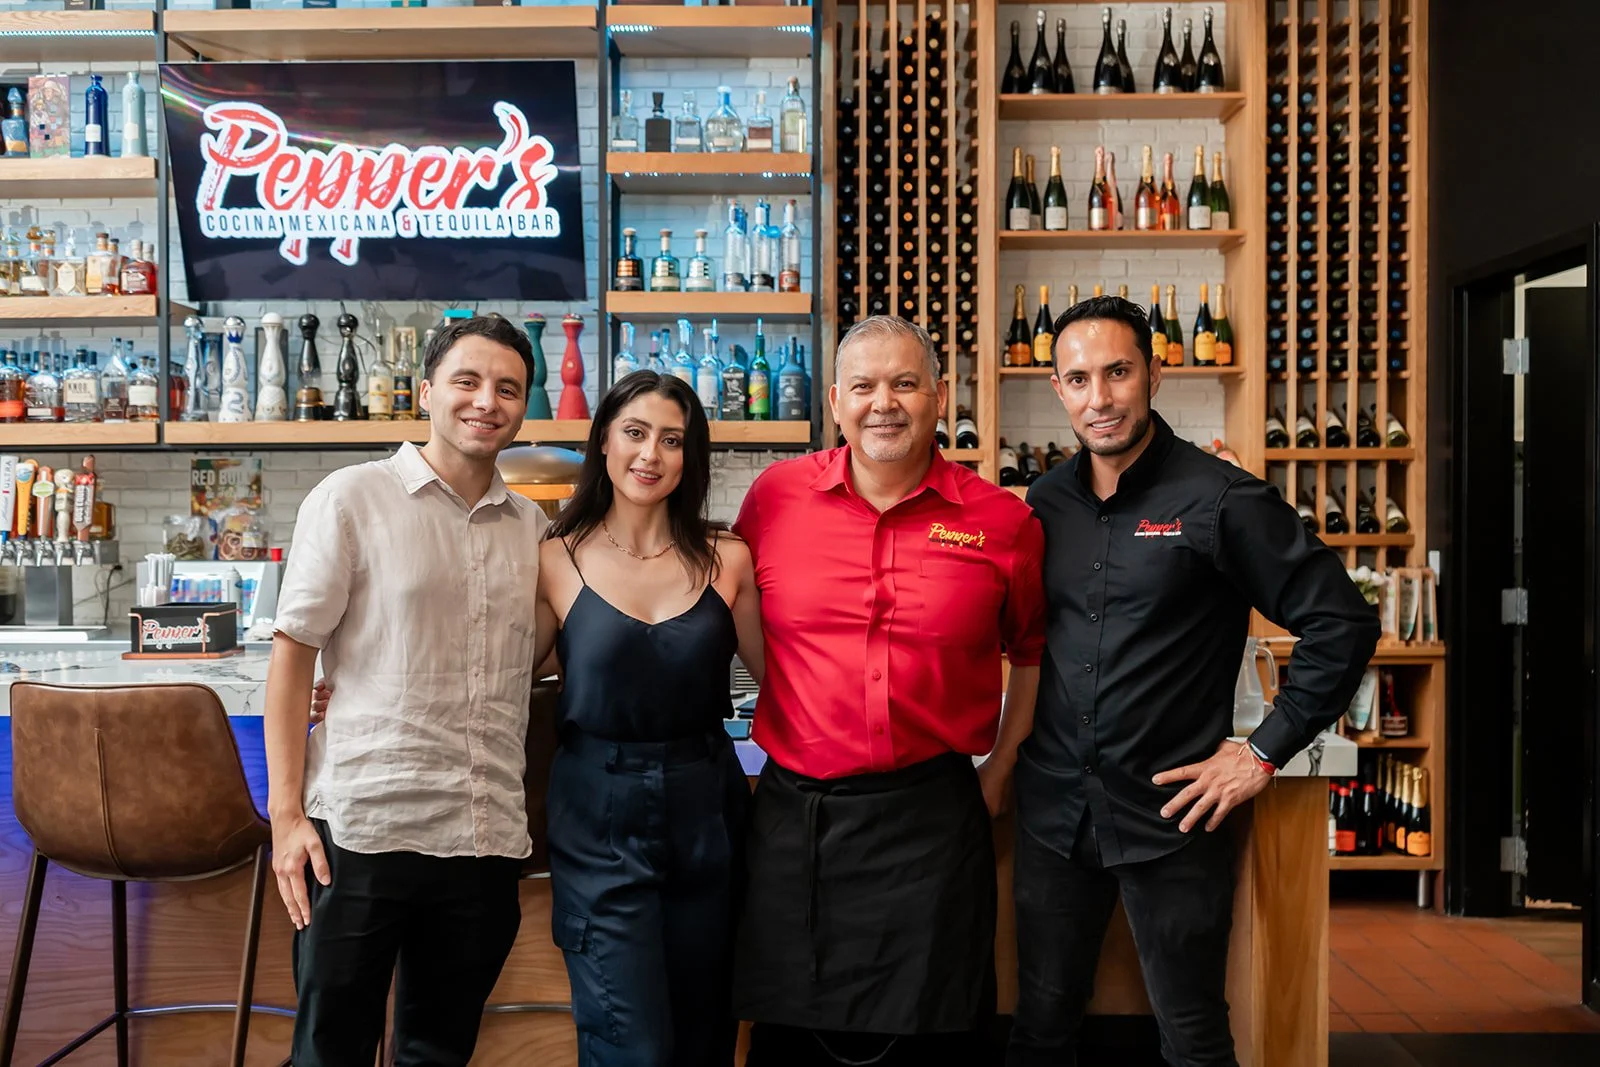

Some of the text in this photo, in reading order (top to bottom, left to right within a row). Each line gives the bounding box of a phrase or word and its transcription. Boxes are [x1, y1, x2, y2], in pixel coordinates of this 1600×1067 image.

[202, 103, 552, 260] Pepper's
[206, 214, 555, 232] COCINA MEXICANA & TEQUILA BAR
[192, 470, 215, 485] RED
[928, 522, 986, 547] Pepper's
